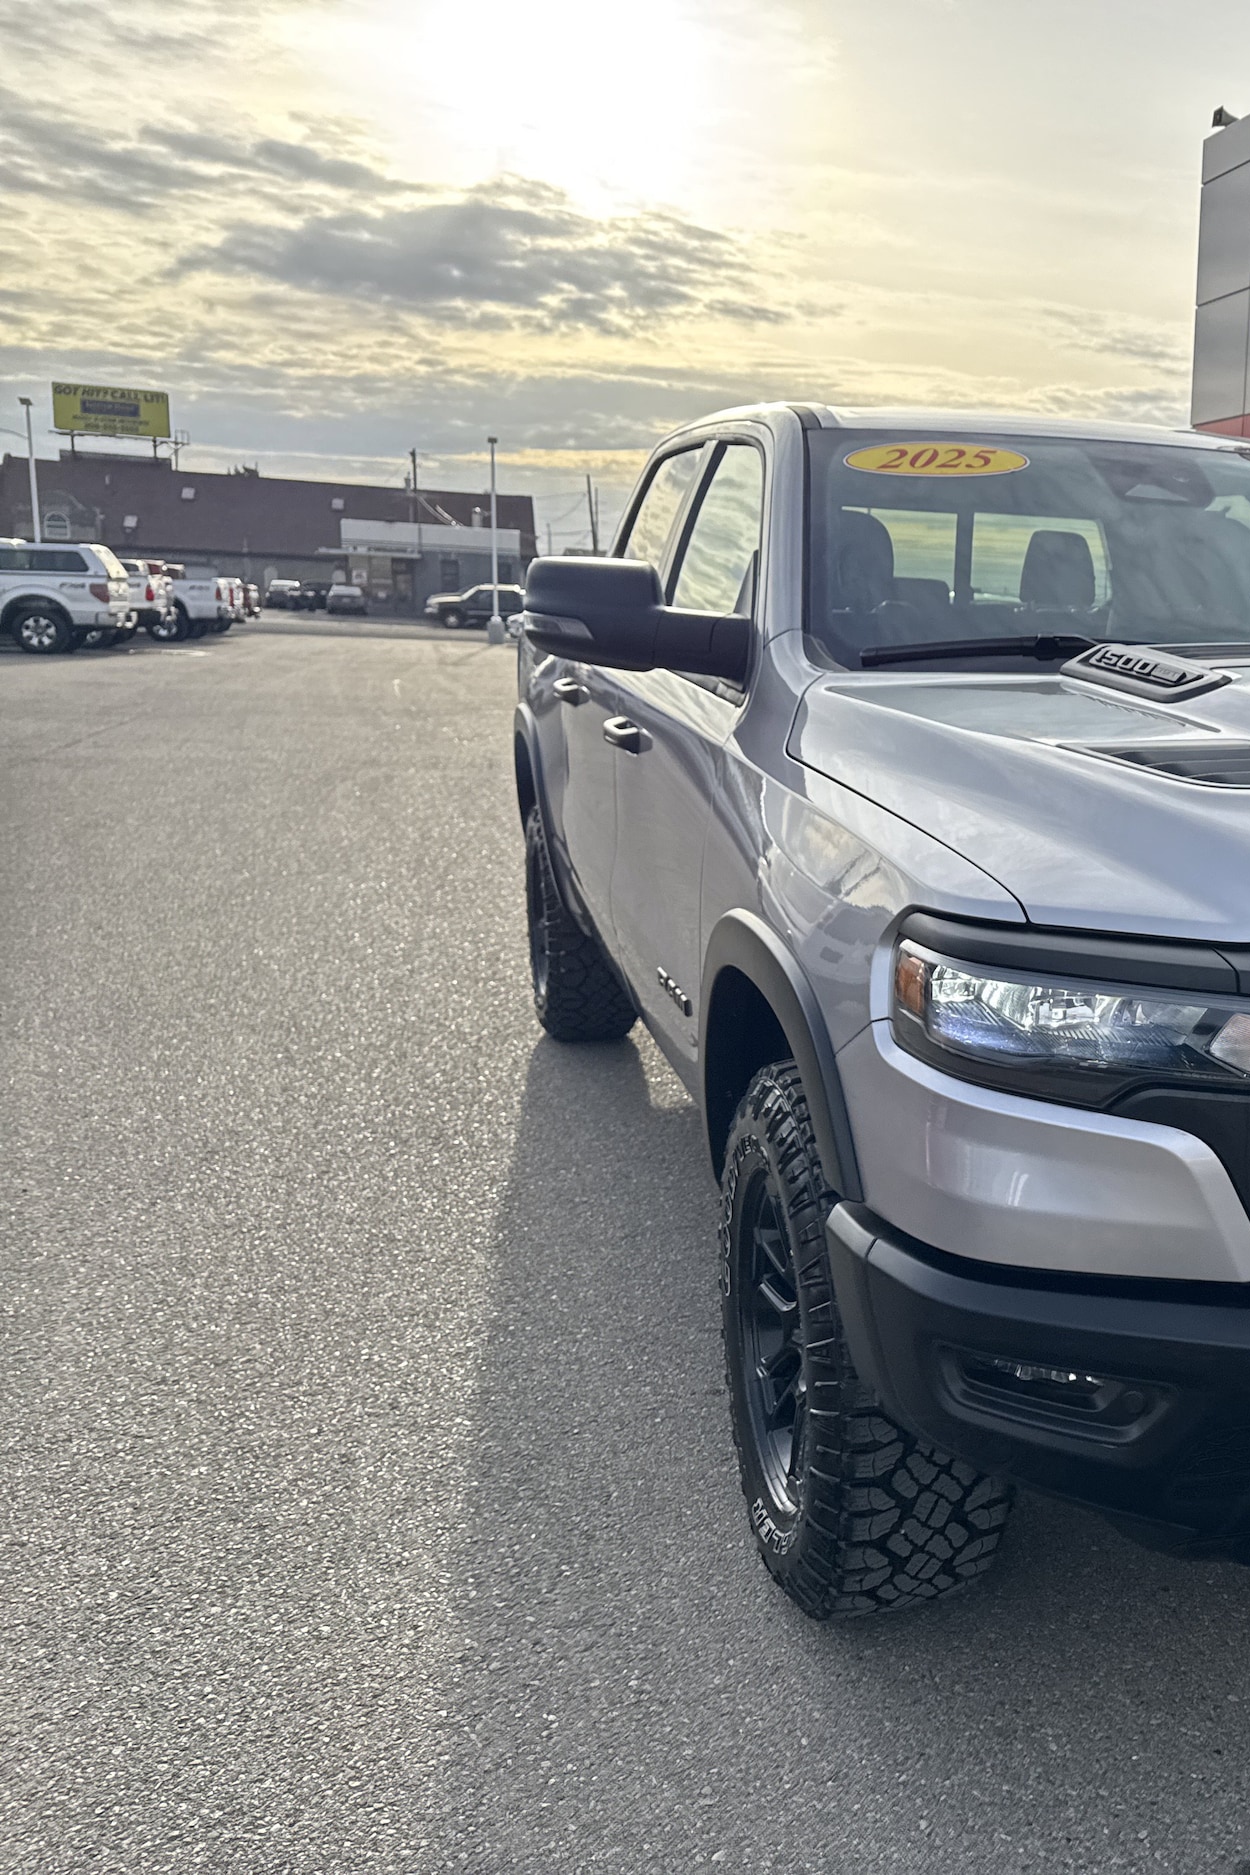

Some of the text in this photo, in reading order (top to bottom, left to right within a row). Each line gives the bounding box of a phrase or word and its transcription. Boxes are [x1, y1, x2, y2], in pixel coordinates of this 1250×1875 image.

[54, 383, 79, 396] GOT
[111, 390, 140, 401] CALL
[876, 447, 998, 470] 2025
[1088, 646, 1154, 677] 1500
